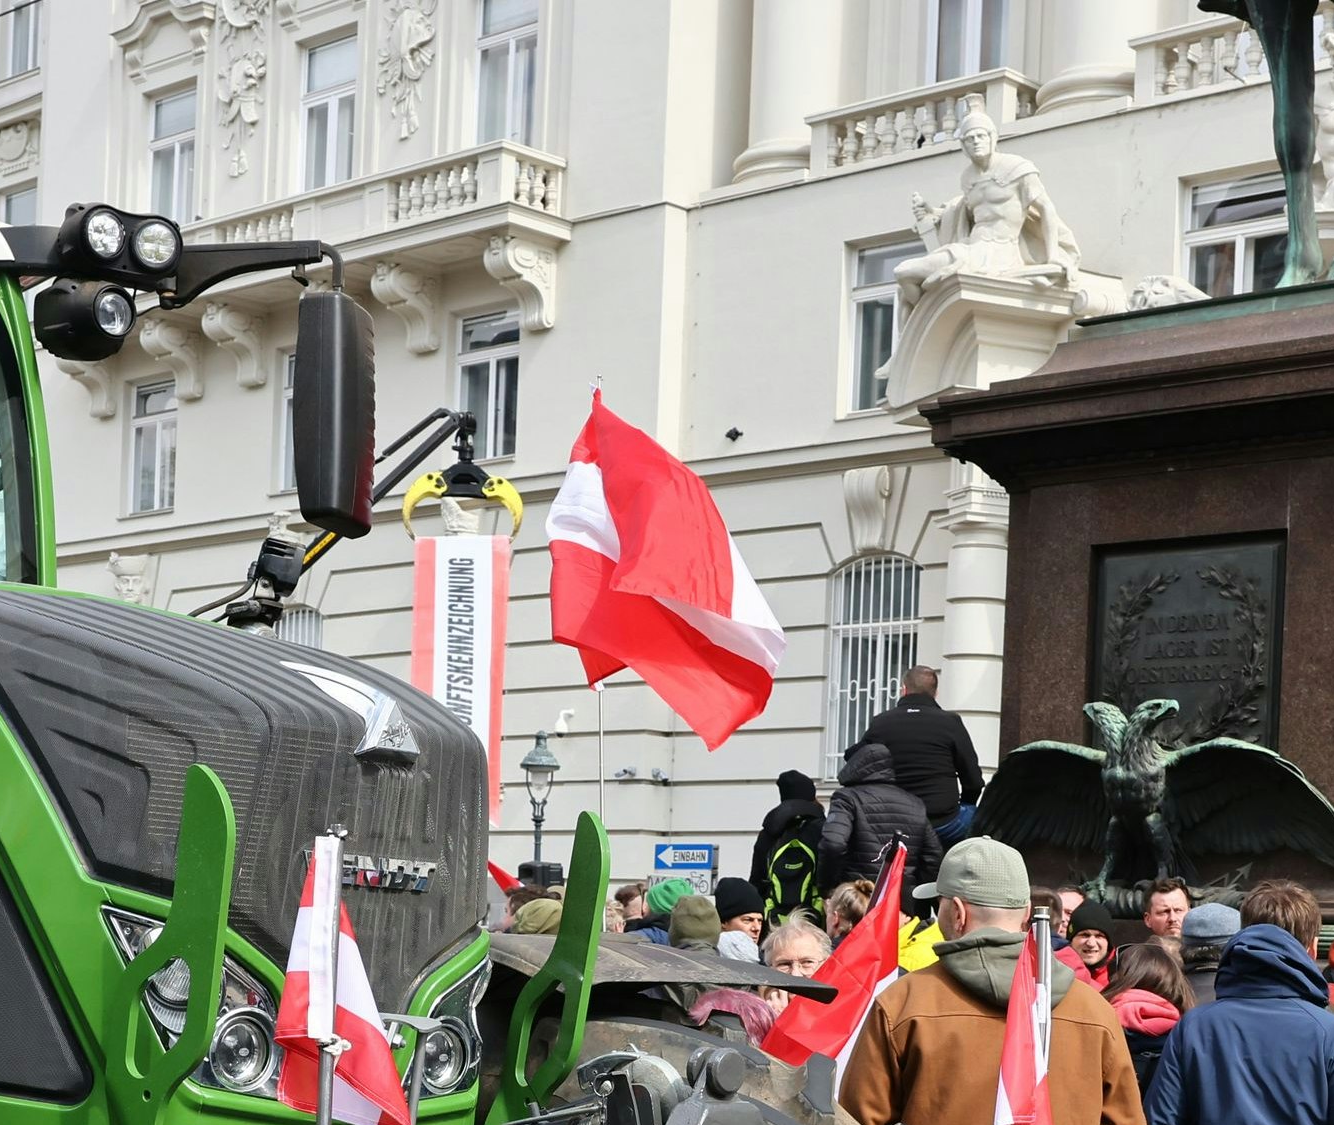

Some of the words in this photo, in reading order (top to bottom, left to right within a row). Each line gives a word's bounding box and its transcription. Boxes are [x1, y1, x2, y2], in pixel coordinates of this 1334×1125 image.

[1146, 616, 1164, 635] IN
[1168, 613, 1230, 633] DEINEM
[1144, 640, 1200, 660] LAGER
[1205, 638, 1230, 657] IST
[673, 851, 706, 862] EINBAHN
[304, 850, 437, 892] ENDT
